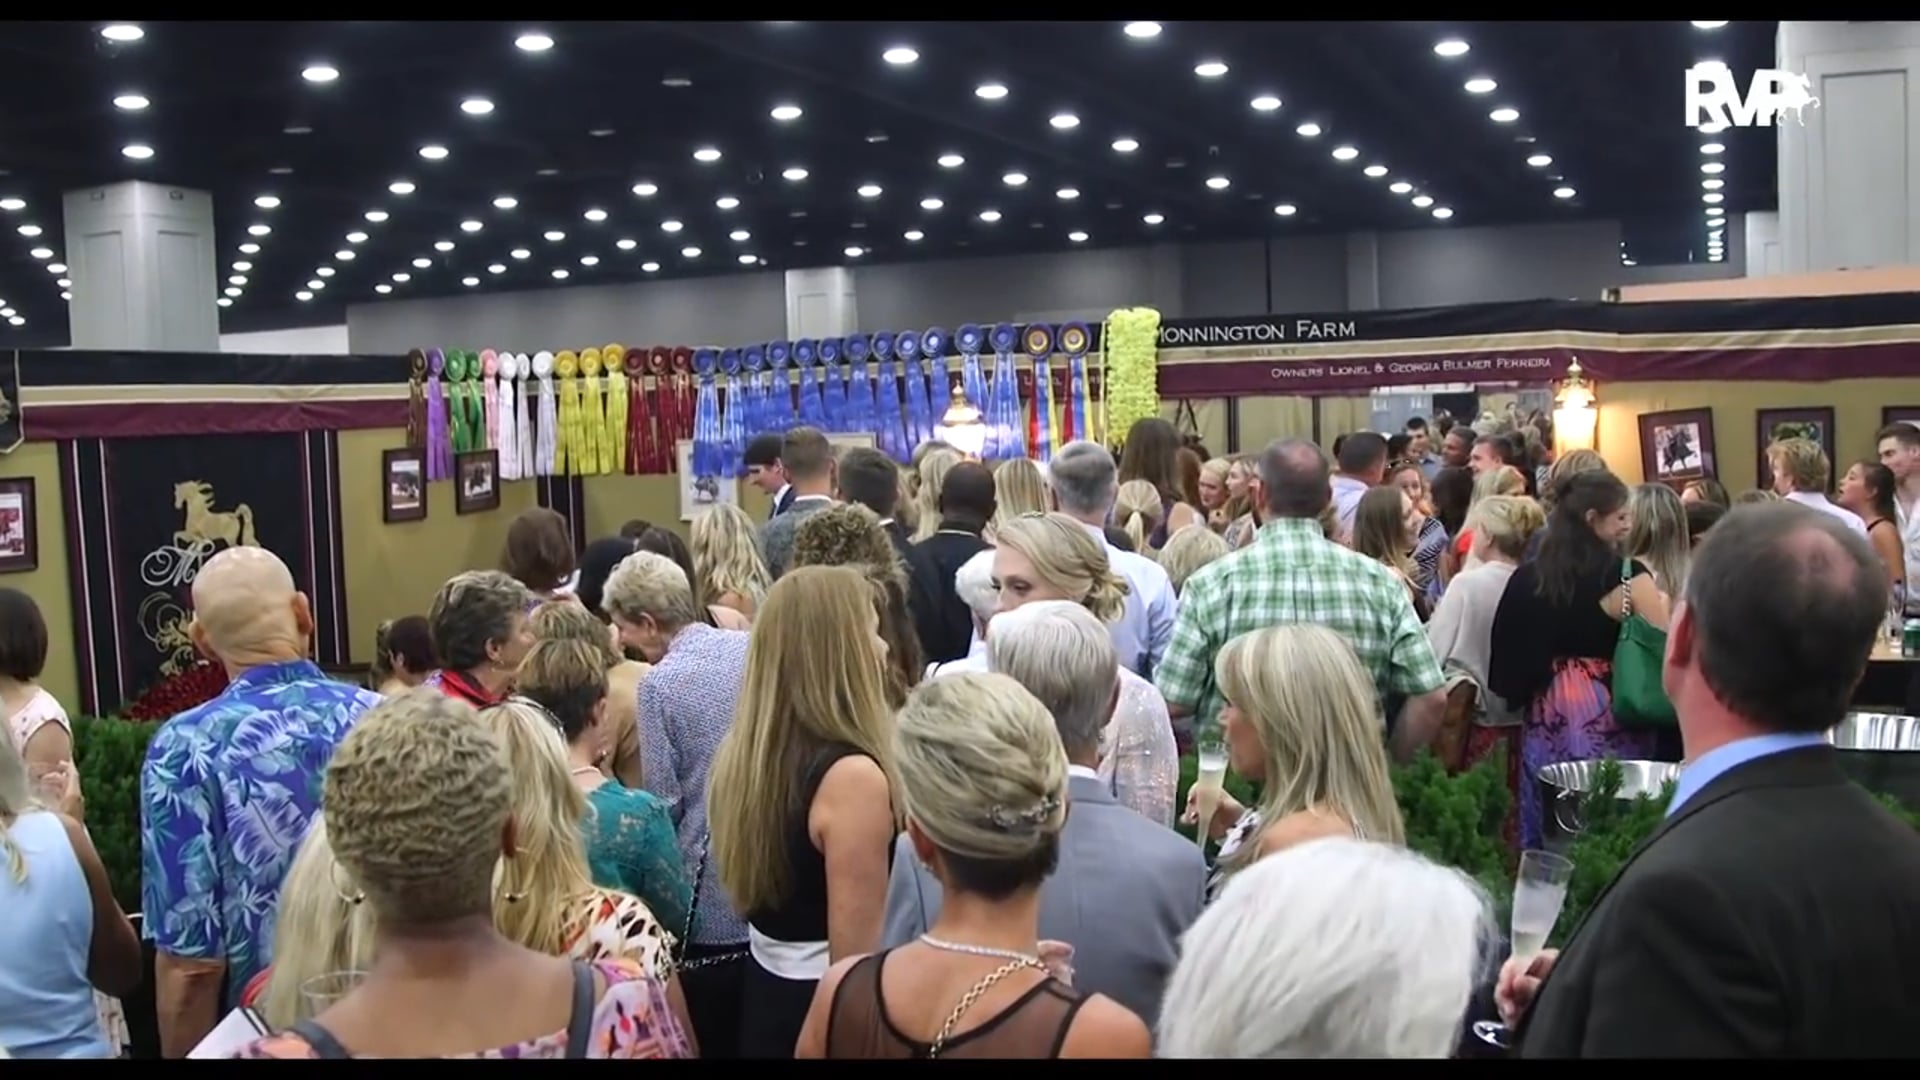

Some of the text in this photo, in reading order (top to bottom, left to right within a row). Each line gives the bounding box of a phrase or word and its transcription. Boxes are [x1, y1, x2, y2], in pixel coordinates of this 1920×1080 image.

[1158, 320, 1356, 343] ONNINGTON FARM
[1271, 367, 1323, 378] OWNERS
[1329, 365, 1372, 376] LIONEL
[1374, 362, 1384, 373] &
[1388, 361, 1440, 373] GEORGIA
[1442, 359, 1491, 371] BULMER
